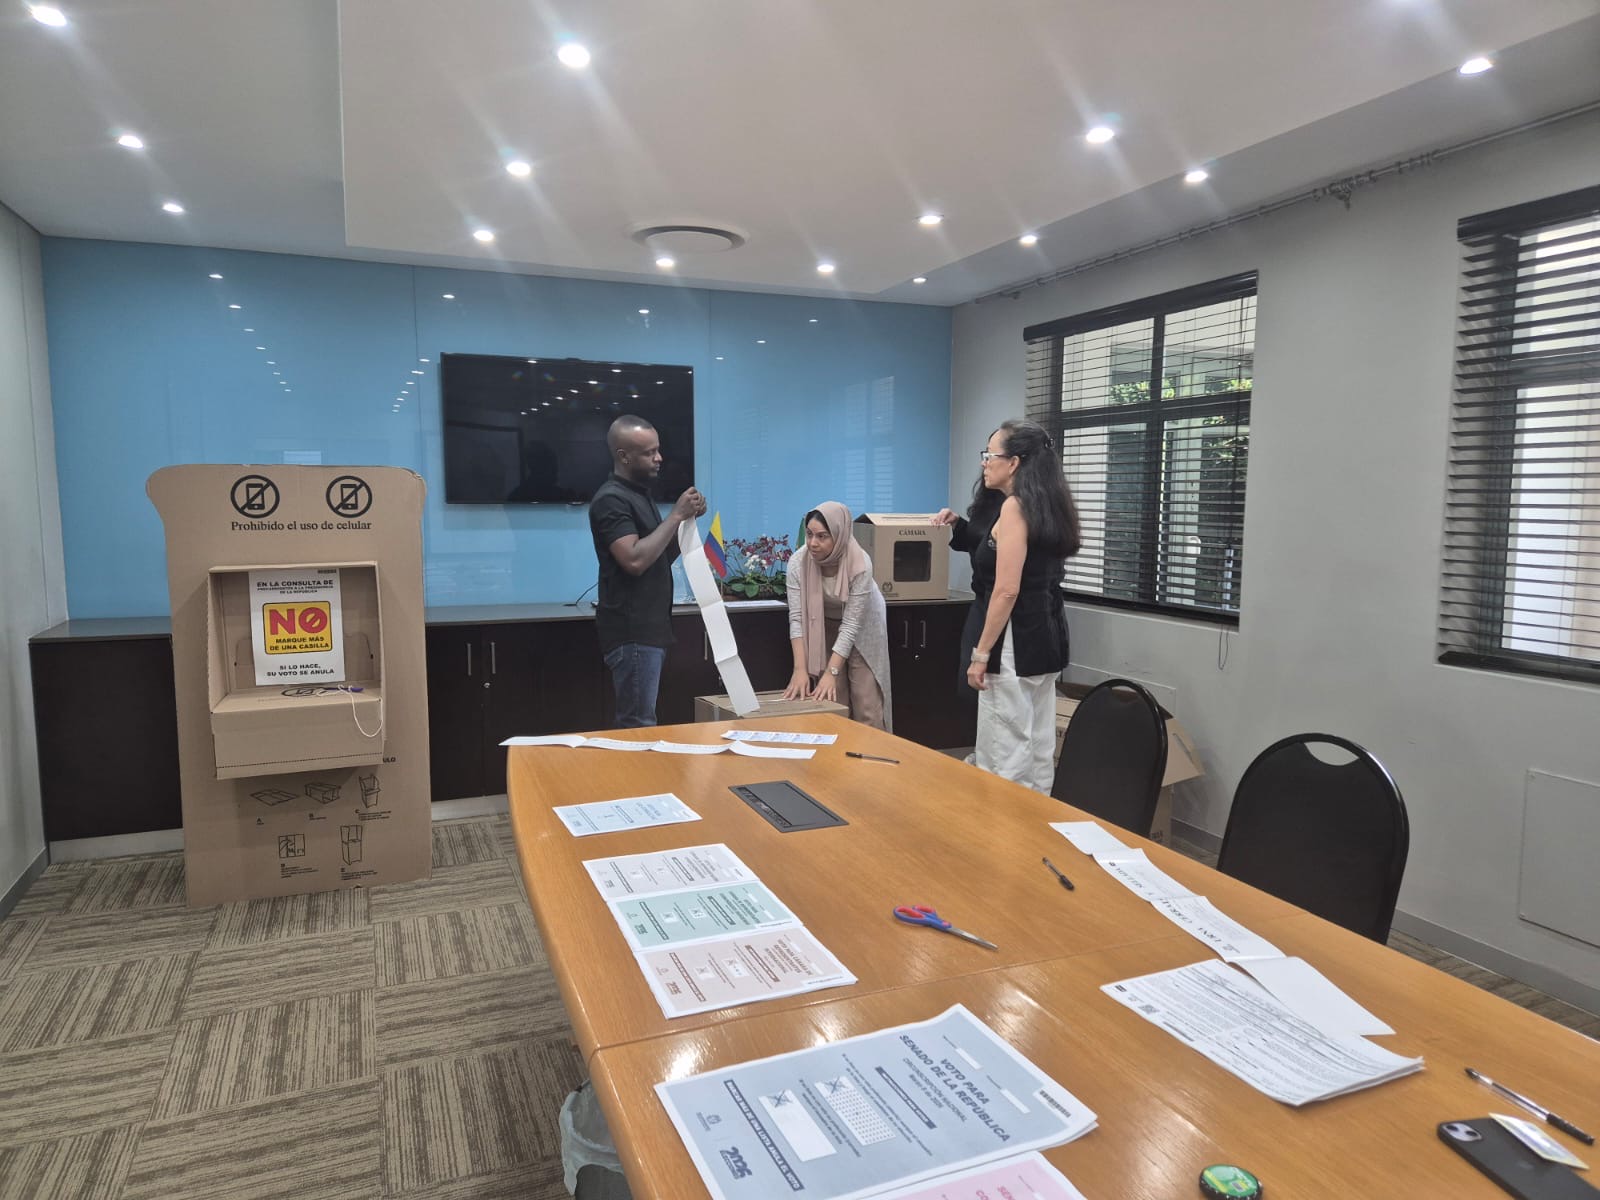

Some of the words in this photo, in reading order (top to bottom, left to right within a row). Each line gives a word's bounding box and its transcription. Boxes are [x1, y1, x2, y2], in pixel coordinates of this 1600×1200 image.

[231, 521, 285, 531] Prohibido
[287, 521, 297, 530] el
[300, 522, 318, 530] uso
[321, 521, 334, 530] de
[336, 520, 372, 530] celular
[269, 607, 328, 635] NO
[898, 1034, 934, 1065] SENADO
[929, 1065, 947, 1078] DE
[941, 1078, 959, 1089] LA
[954, 1090, 1013, 1141] REPÚBLICA
[938, 1058, 967, 1081] VOTO
[962, 1081, 991, 1104] PARA
[757, 1130, 773, 1145] LISTA
[785, 1172, 802, 1189] VOTO
